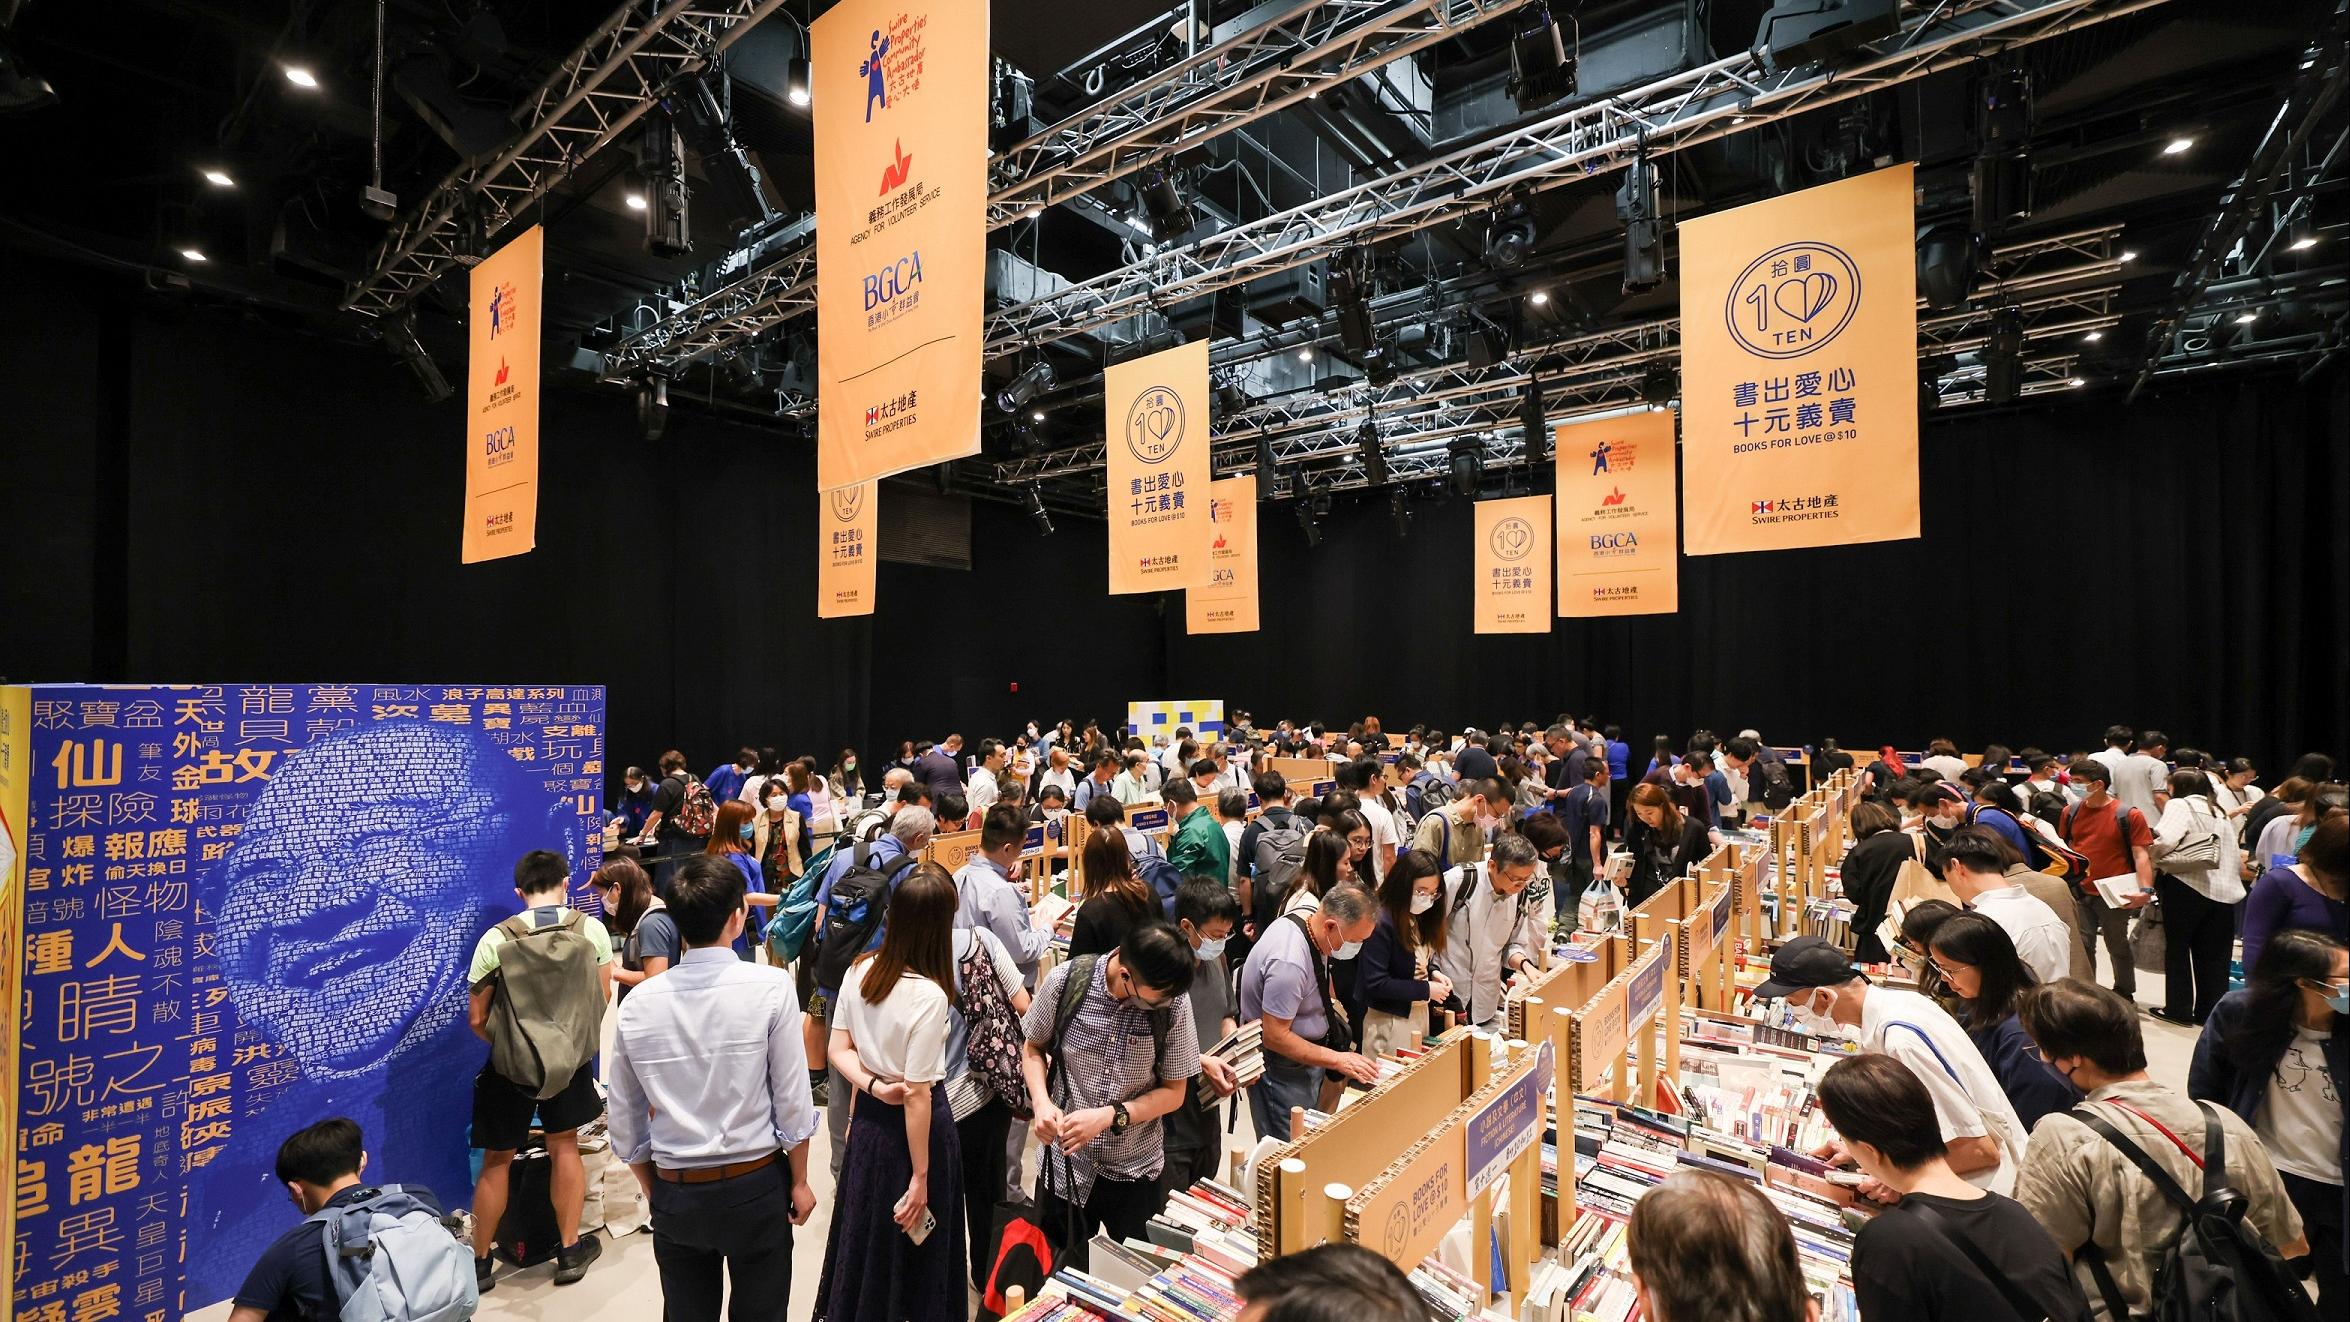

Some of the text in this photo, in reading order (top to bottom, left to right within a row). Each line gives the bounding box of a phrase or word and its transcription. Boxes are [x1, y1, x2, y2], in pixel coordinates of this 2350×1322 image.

[888, 13, 908, 35] Swire
[890, 15, 928, 49] Properties
[850, 187, 941, 246] AGENCY FOR VOLUNTEER SERVICE
[868, 181, 924, 224] 義務工作發展局
[1771, 254, 1811, 278] 拾圓
[863, 250, 923, 312] BGCA
[1773, 327, 1812, 346] TEN
[1733, 367, 1856, 407] 書出愛心
[880, 390, 918, 421] 太古地產
[1733, 397, 1856, 437] 十元義賣
[486, 426, 515, 455] BGCA
[865, 413, 917, 442] SWIRE PROPERTIES
[1147, 443, 1165, 455] TEN
[1733, 440, 1768, 454] BOOKS
[1770, 438, 1792, 449] FOR
[1795, 434, 1822, 446] LOVE
[1131, 470, 1185, 495] 書出愛心
[1131, 491, 1185, 516] 十元義賣
[1777, 494, 1839, 511] 太古地產
[1131, 517, 1147, 527] BOOKS
[1147, 516, 1158, 524] FOR
[1158, 514, 1171, 523] LOVE
[1752, 510, 1839, 525] SWIRE PROPERTIES
[1590, 532, 1638, 550] BGCA
[1151, 554, 1179, 566] 太古地產
[1492, 566, 1532, 578] 書出愛心
[1211, 568, 1234, 582] GCA
[1492, 578, 1532, 590] 十元義賣
[1607, 586, 1637, 595] 太古地產
[373, 687, 431, 701] 風水
[442, 687, 564, 700] 浪子高達系列
[34, 698, 164, 730] 聚寶盆
[542, 725, 602, 738] 支離
[52, 738, 122, 790] 仙
[137, 743, 163, 783] 筆友
[171, 698, 204, 824] 天外金球
[49, 791, 158, 830] 探險
[104, 828, 188, 862] 報應
[61, 835, 95, 889] 爆炸
[105, 860, 187, 881] 偷天換日
[94, 879, 188, 921] 怪物
[151, 919, 185, 1024] 陰魂不散
[189, 1037, 217, 1074] 病毒
[82, 1096, 153, 1123] 非常遭遇
[1503, 1099, 1528, 1130] LITERATURE
[152, 1125, 171, 1184] 地底奇人
[1412, 1176, 1435, 1205] BOOKS
[1435, 1162, 1448, 1182] FOR
[1413, 1201, 1429, 1223] LOVE
[134, 1191, 170, 1307] 天皇巨星
